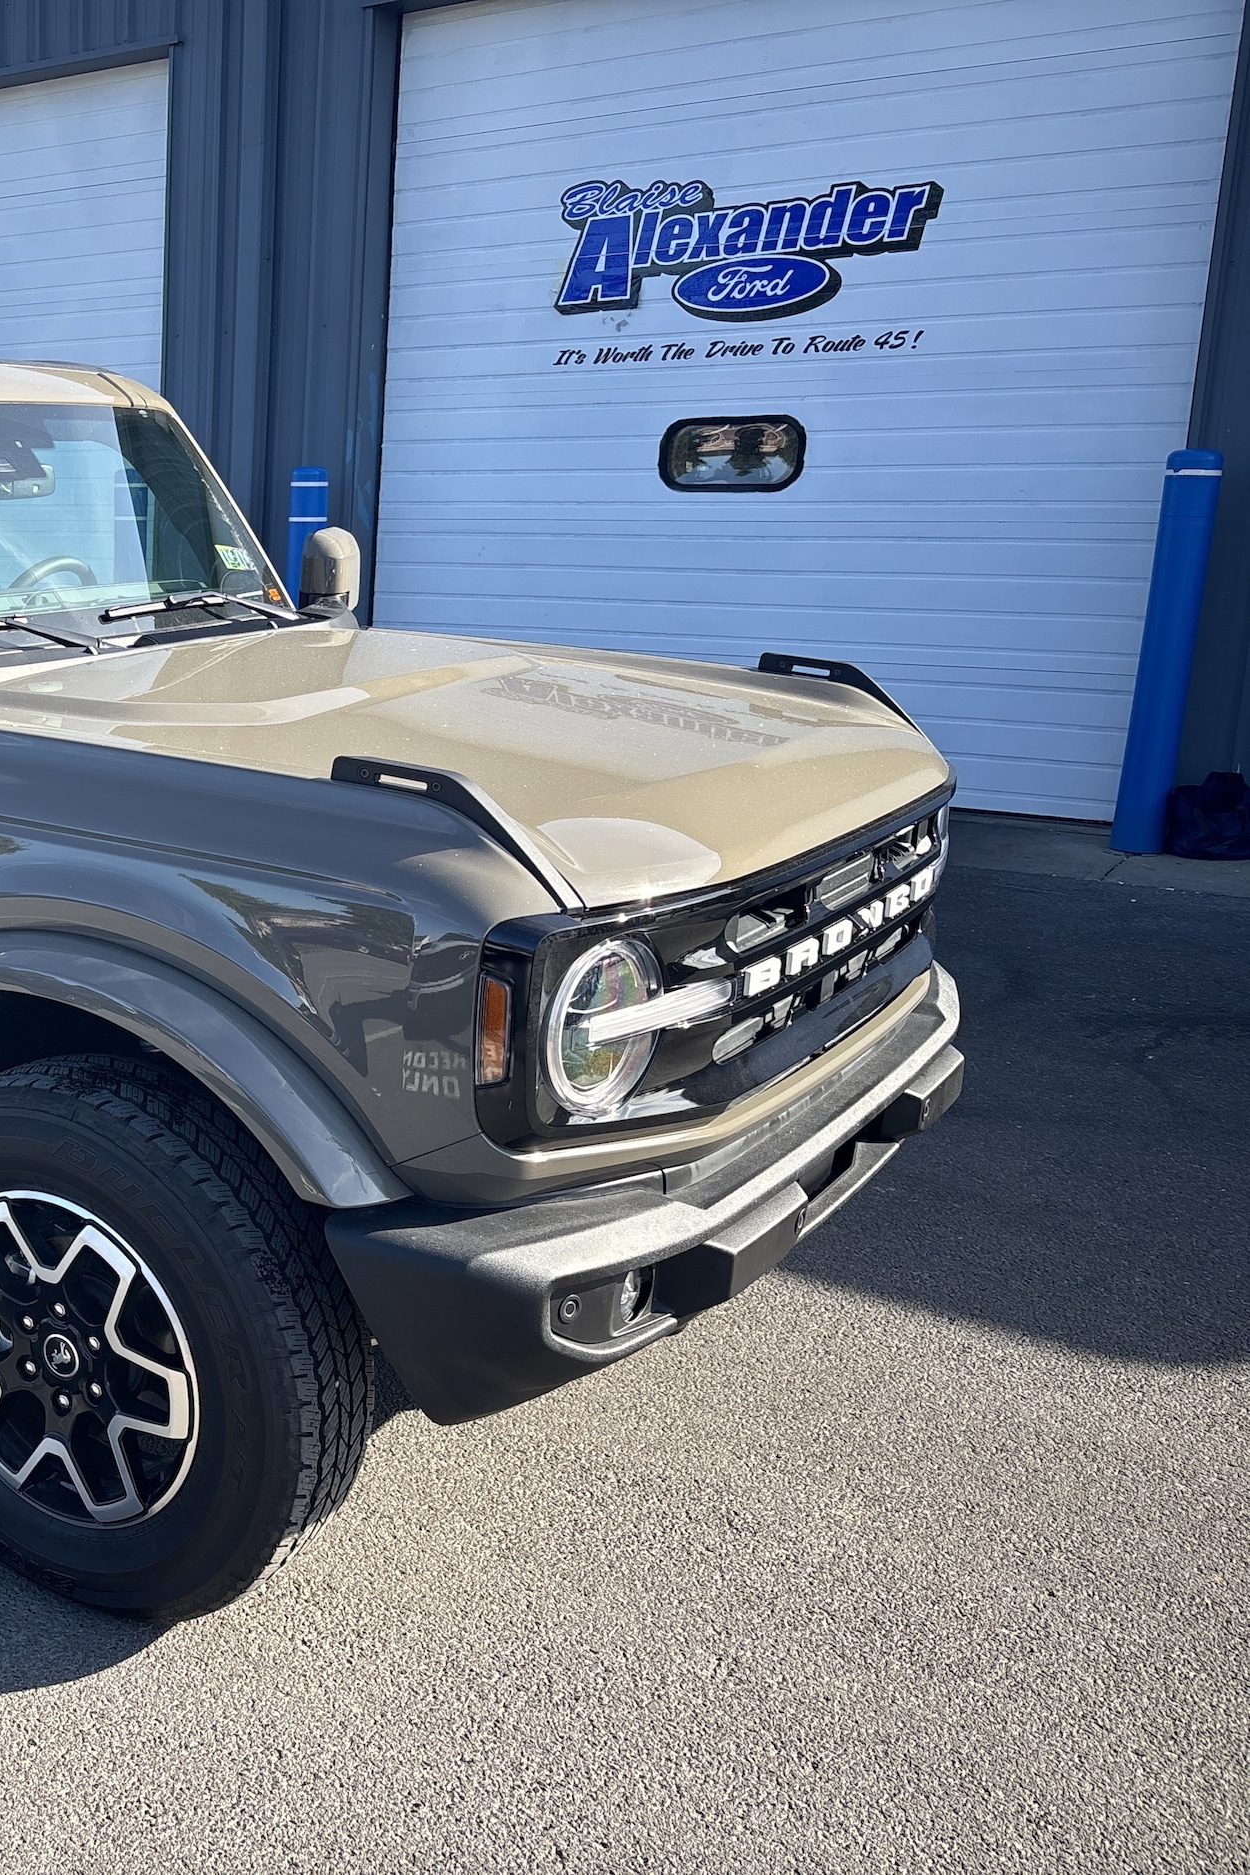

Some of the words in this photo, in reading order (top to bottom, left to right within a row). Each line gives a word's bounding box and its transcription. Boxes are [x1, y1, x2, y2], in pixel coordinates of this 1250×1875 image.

[563, 181, 704, 220] Blaise
[558, 181, 935, 306] Alexander
[707, 264, 791, 301] Ford
[553, 350, 587, 366] It's
[592, 344, 653, 365] Worth
[660, 342, 694, 362] The
[705, 340, 764, 361] Drive
[771, 337, 795, 356] To
[804, 334, 865, 353] Route
[875, 330, 925, 351] 45!
[742, 867, 935, 997] BRONCO
